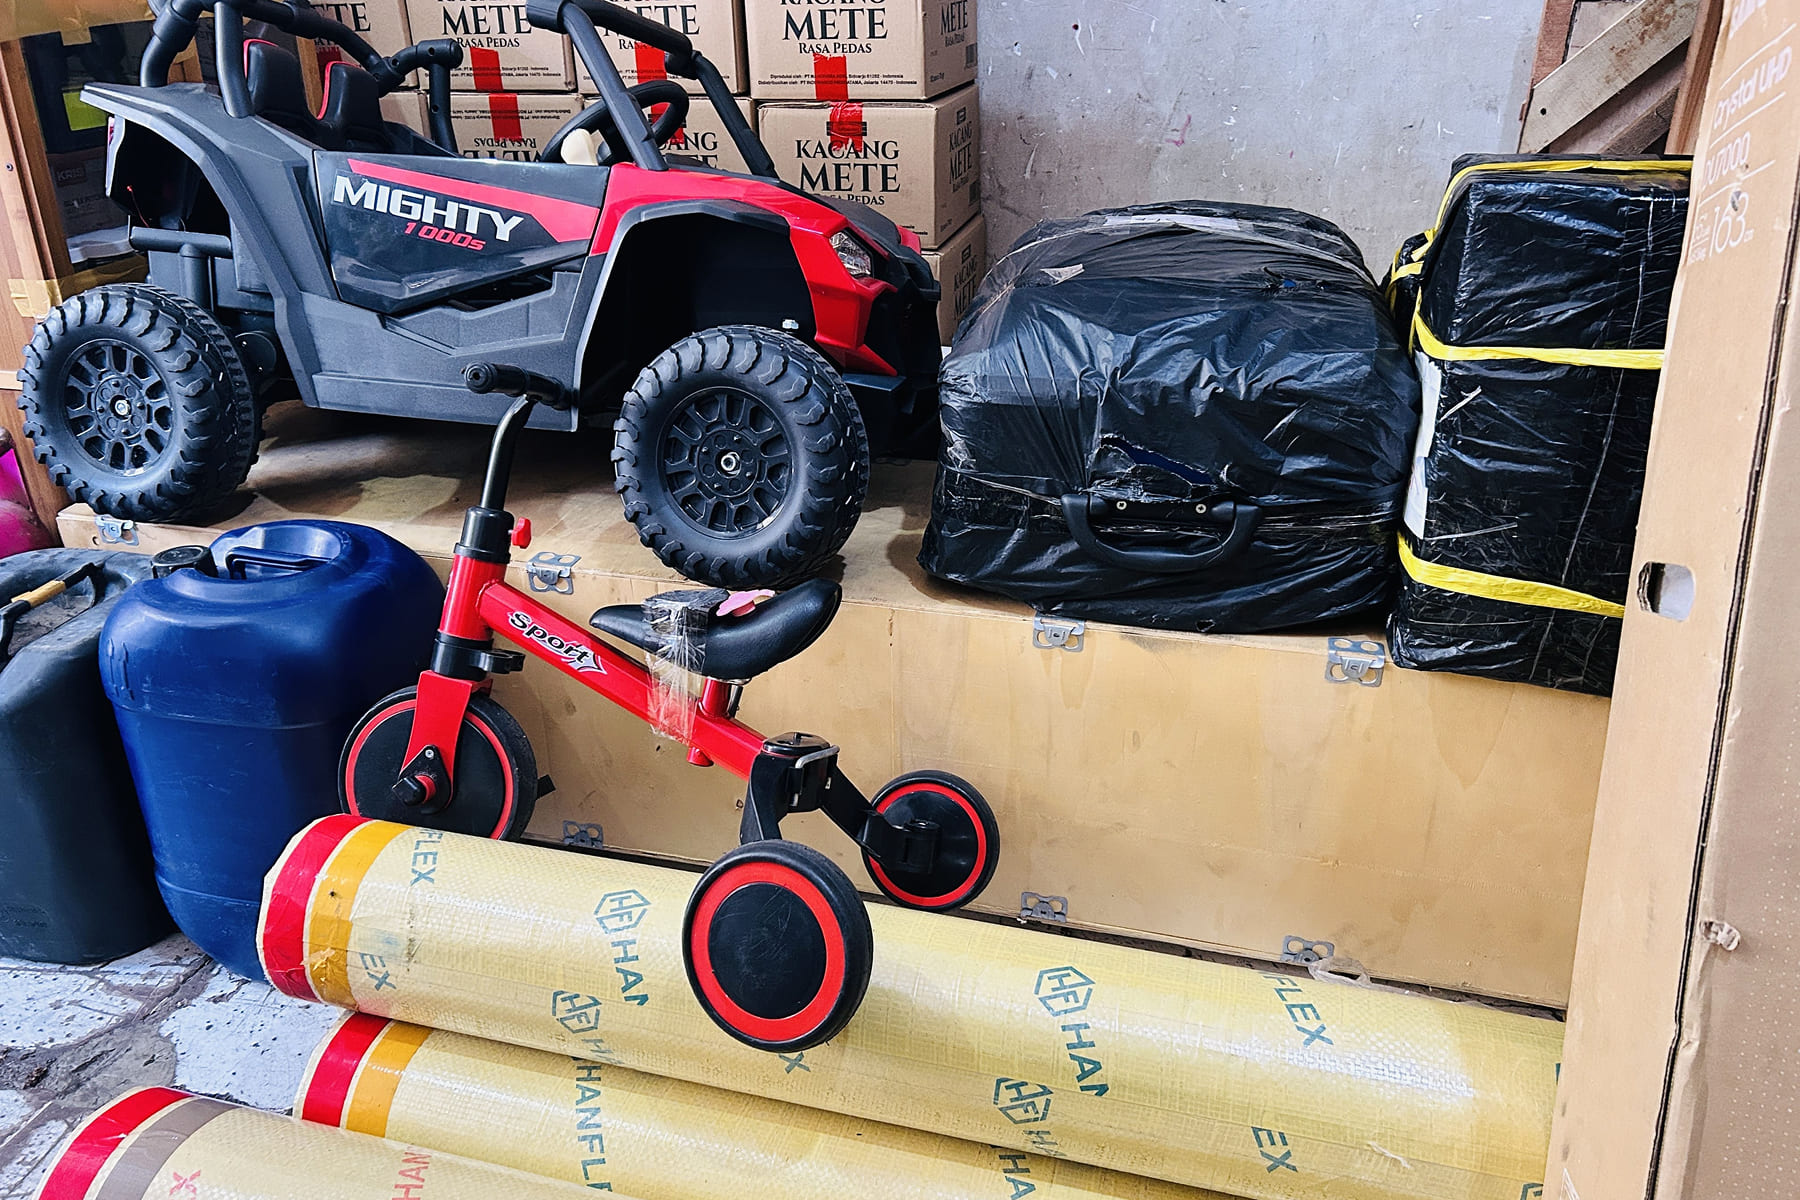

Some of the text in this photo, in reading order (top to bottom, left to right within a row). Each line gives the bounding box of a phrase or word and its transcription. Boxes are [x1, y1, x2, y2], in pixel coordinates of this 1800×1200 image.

[442, 5, 532, 35] METE
[782, 8, 888, 40] METE
[941, 0, 968, 35] METE
[458, 37, 520, 48] RASA PEDAS
[799, 42, 872, 53] RASA PEDAS
[1758, 46, 1793, 95] UHD
[474, 137, 537, 148] RASA PEDAS
[795, 139, 900, 160] KACANG
[949, 121, 972, 153] KACANG
[801, 162, 900, 193] METE
[949, 142, 972, 184] METE
[334, 175, 524, 242] MIGHTY
[848, 193, 884, 205] PEDAS
[404, 221, 486, 251] 1000s
[510, 611, 590, 664] Sport
[410, 830, 443, 886] FLEX
[359, 952, 397, 991] EX
[1263, 975, 1335, 1048] FLEX
[1251, 1126, 1299, 1174] EX
[999, 1154, 1036, 1200] HA
